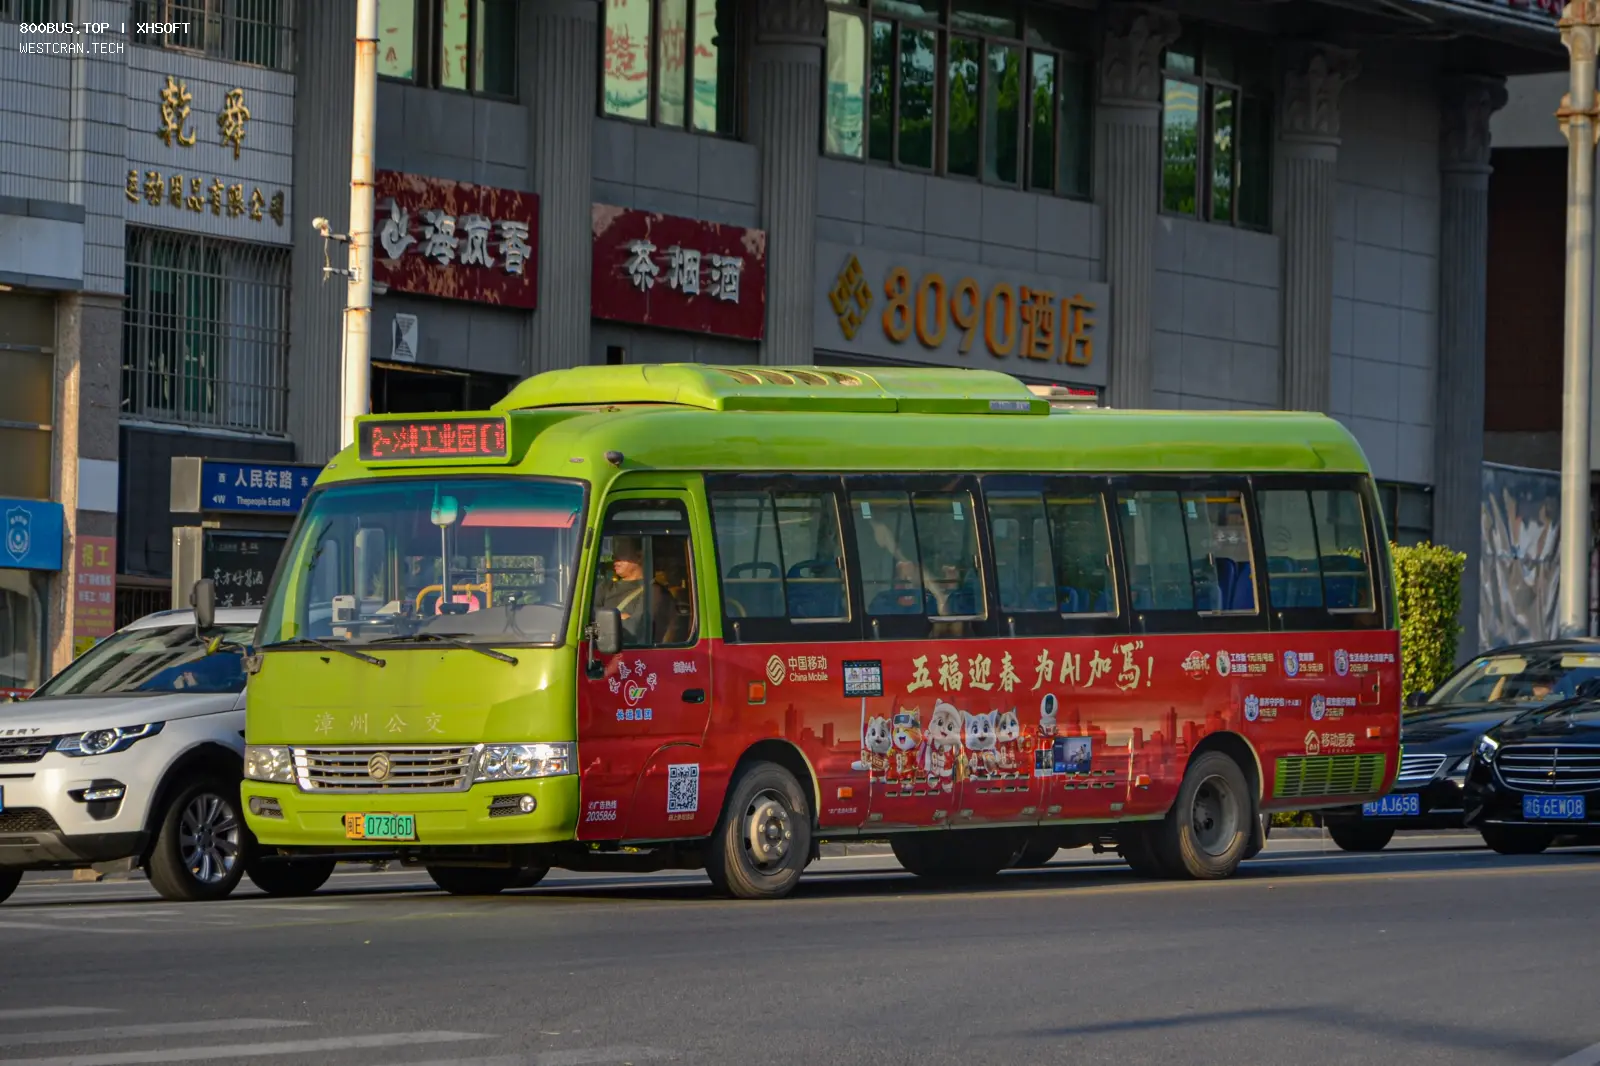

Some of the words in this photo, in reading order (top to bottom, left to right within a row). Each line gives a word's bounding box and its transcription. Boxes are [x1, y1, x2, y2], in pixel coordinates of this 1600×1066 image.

[627, 239, 743, 304] 茶烟酒
[882, 266, 1097, 366] 8090酒店
[235, 469, 292, 489] 人民东路
[237, 496, 267, 507] Thepeople
[268, 498, 281, 506] East
[282, 498, 290, 507] Rd
[788, 655, 828, 671] 中国移动
[789, 672, 808, 682] China
[808, 671, 828, 681] Mobile
[907, 652, 1021, 693] 五福迎春
[314, 712, 446, 735] 漳州公交
[616, 708, 653, 721] 长运集团
[586, 811, 617, 821] 2035866
